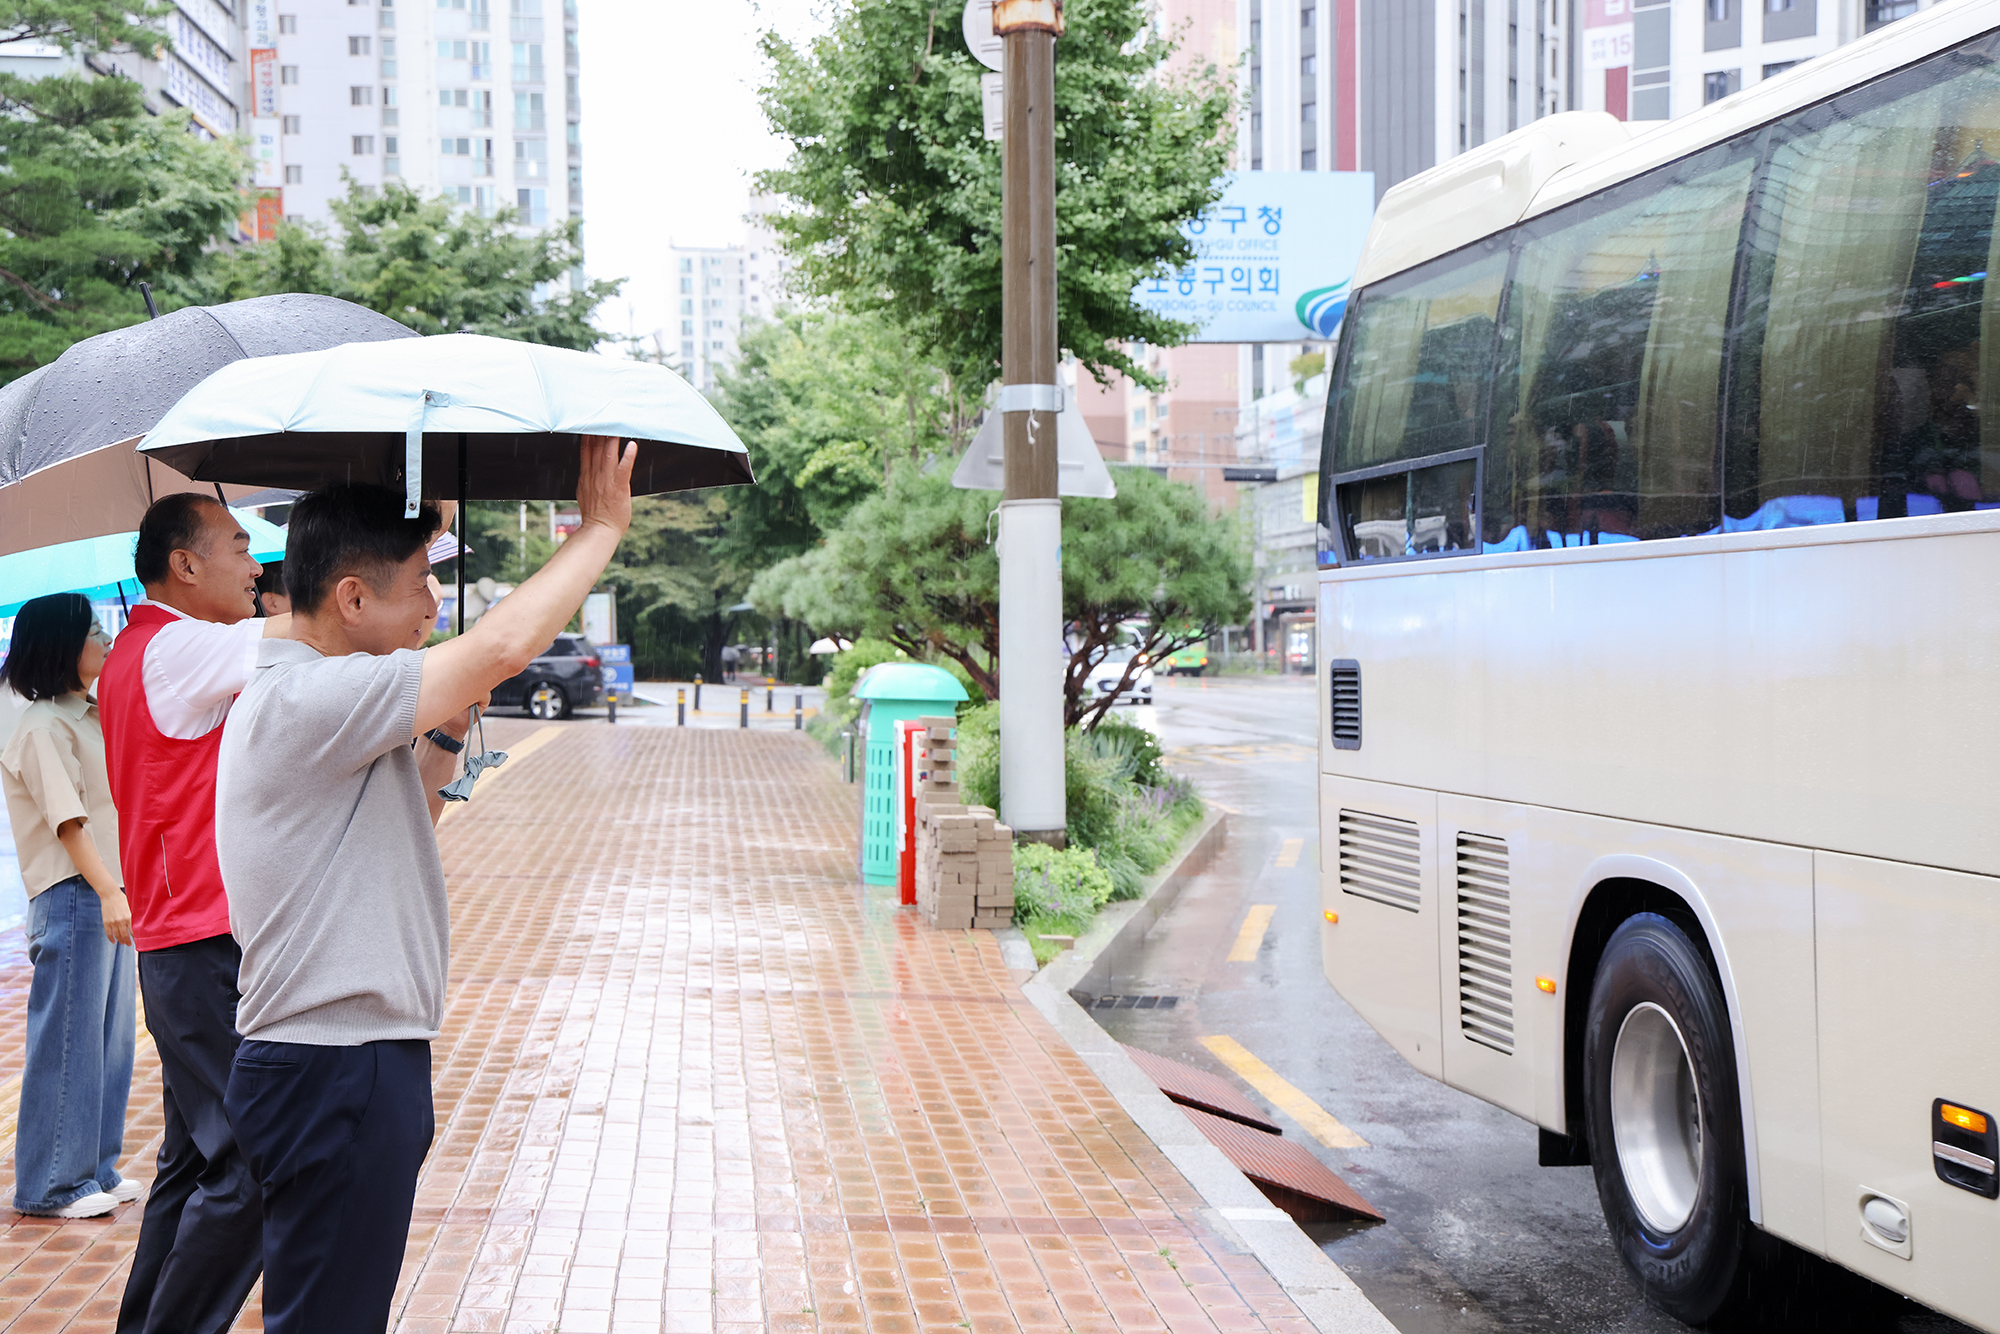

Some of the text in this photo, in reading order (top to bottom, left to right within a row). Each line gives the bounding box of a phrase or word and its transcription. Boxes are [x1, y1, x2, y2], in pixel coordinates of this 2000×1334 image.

[1609, 34, 1632, 58] 15
[1237, 239, 1279, 251] OFFICE
[1226, 300, 1277, 313] COUNCIL
